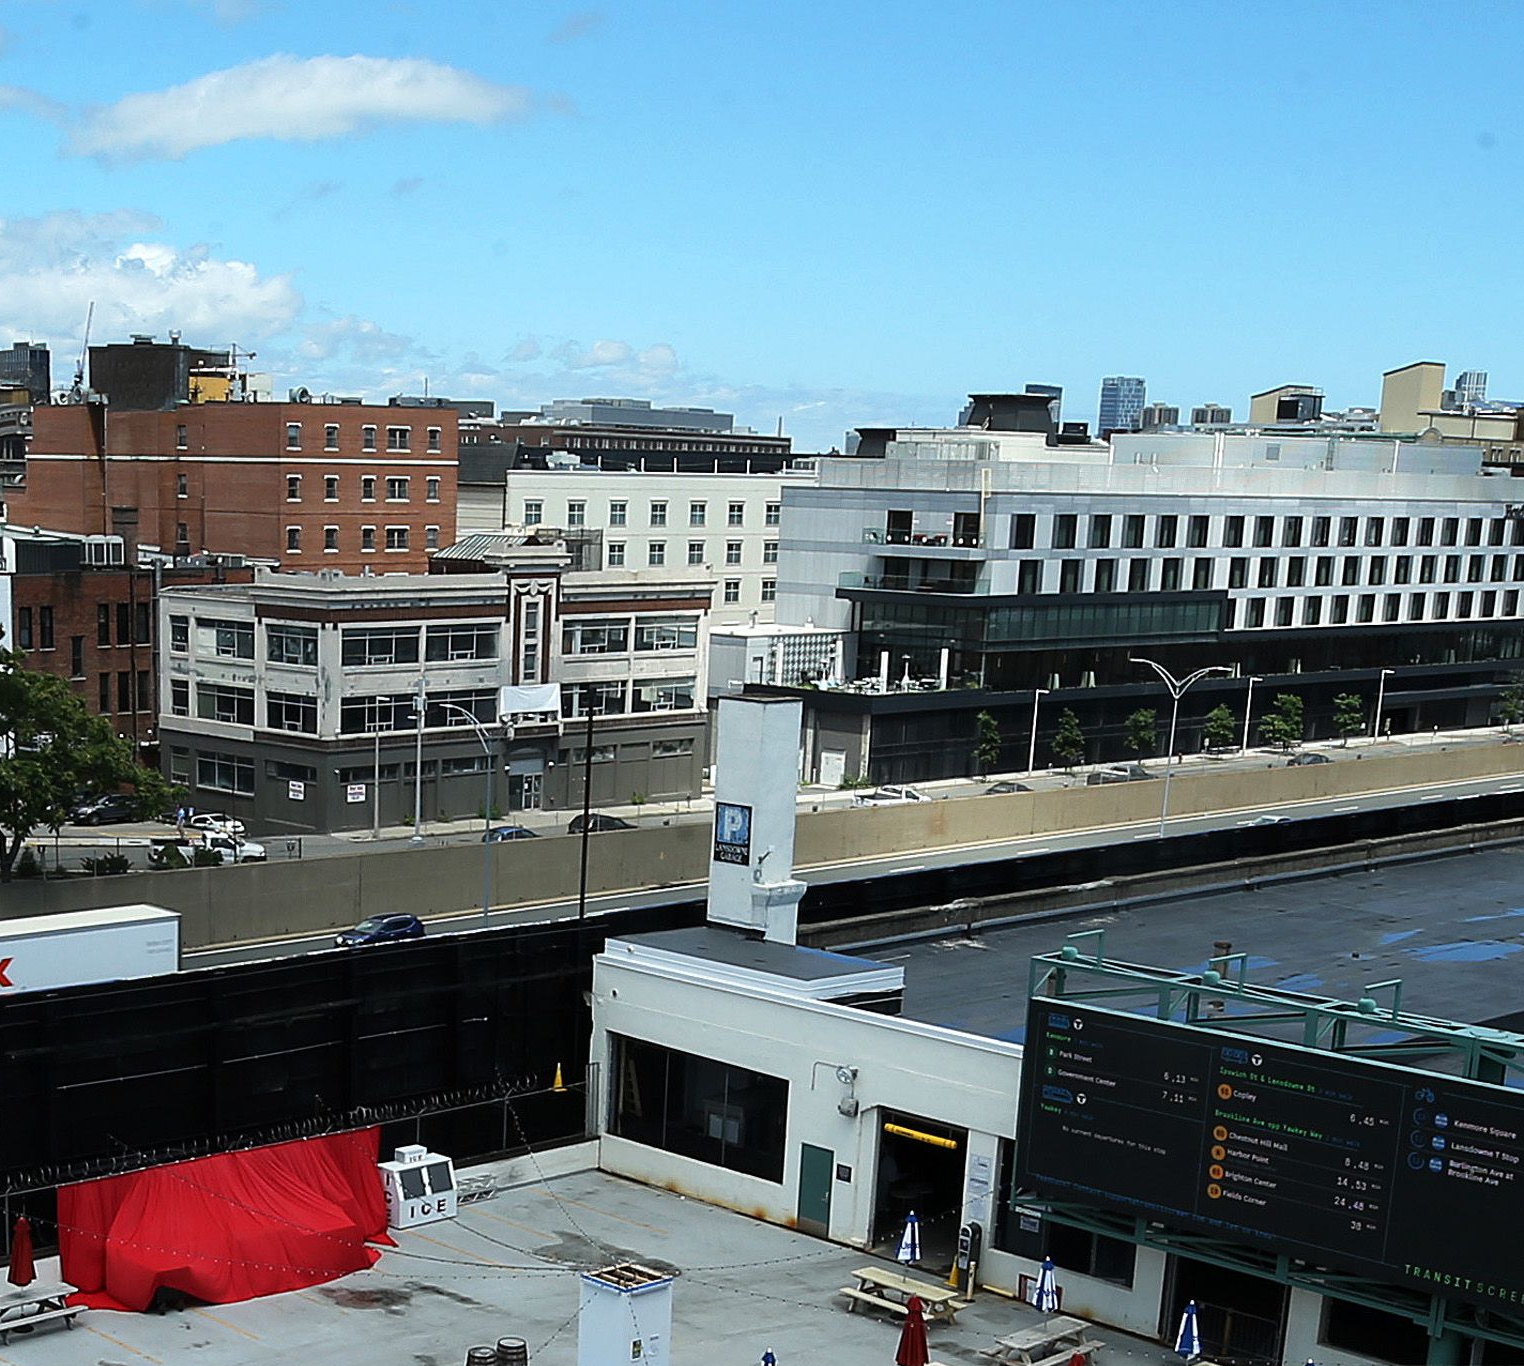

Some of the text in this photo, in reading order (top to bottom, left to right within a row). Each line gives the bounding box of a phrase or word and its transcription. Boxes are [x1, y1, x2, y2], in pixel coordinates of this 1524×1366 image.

[723, 808, 743, 840] P
[1059, 1050, 1073, 1060] Park
[1073, 1051, 1093, 1064] Street
[1057, 1069, 1094, 1084] Government
[1095, 1076, 1117, 1088] Center
[1219, 1066, 1248, 1080] Ipswich
[1233, 1089, 1257, 1103] Copley
[1214, 1108, 1323, 1140] Brookline Way
[1454, 1119, 1488, 1134] Kenmore
[1489, 1126, 1517, 1140] Square
[1228, 1131, 1259, 1145] Chestnut
[1259, 1138, 1272, 1148] Hill
[1273, 1140, 1289, 1152] Mall
[1227, 1149, 1251, 1160] Harbor
[1251, 1152, 1270, 1165] Point
[1451, 1141, 1494, 1159] Lansdowne
[1501, 1152, 1520, 1165] Stop
[1224, 1170, 1253, 1184] Brighton
[1253, 1175, 1277, 1189] Center
[1447, 1169, 1500, 1186] Brookline Ave
[1449, 1159, 1489, 1175] Burlington
[1489, 1168, 1504, 1179] Ave
[1505, 1172, 1514, 1181] at
[410, 1198, 447, 1219] ICE
[1222, 1189, 1243, 1202] Fields
[1243, 1194, 1267, 1206] Corner
[1349, 1220, 1361, 1231] 38
